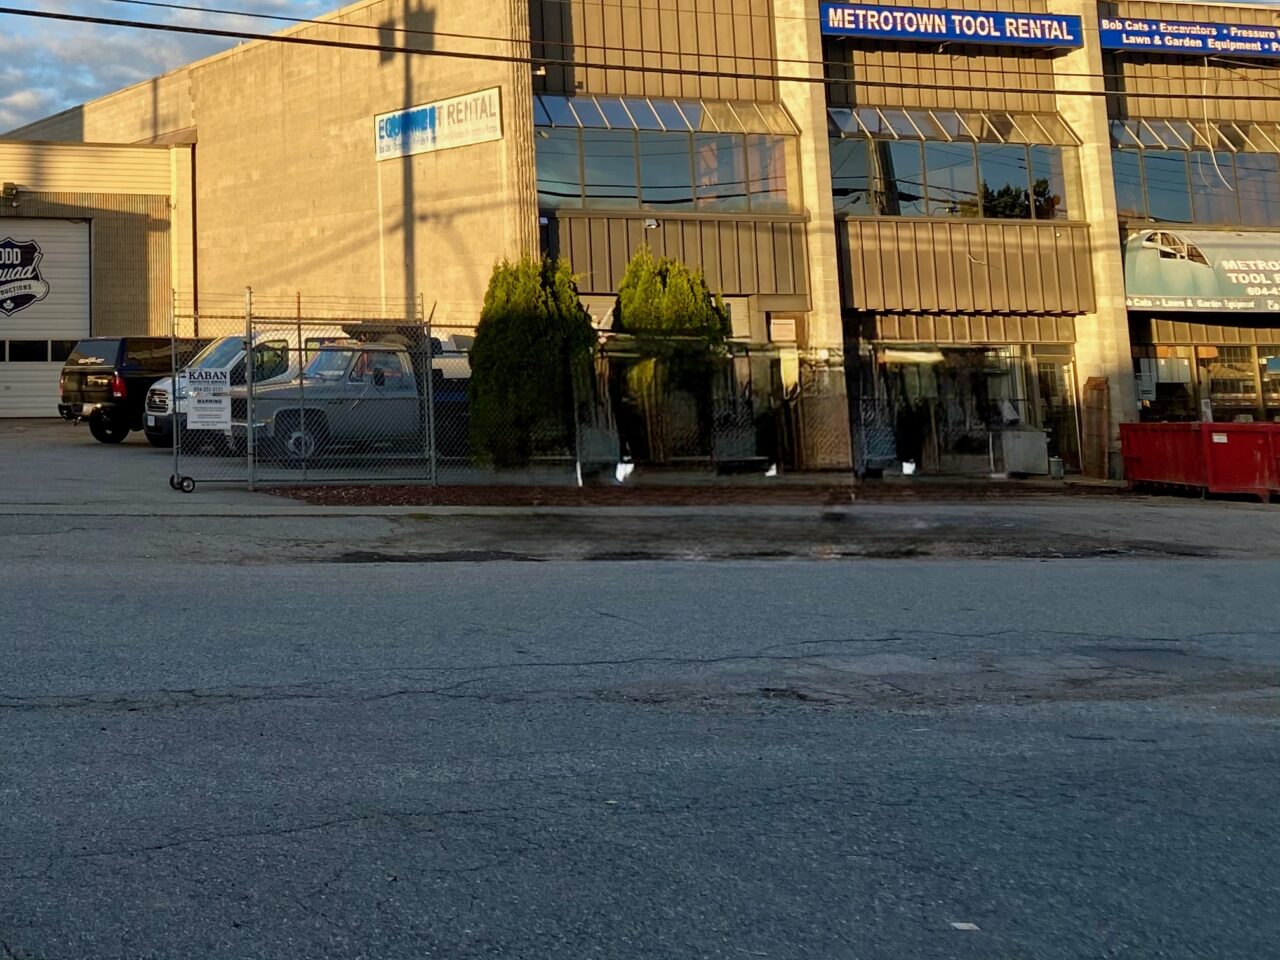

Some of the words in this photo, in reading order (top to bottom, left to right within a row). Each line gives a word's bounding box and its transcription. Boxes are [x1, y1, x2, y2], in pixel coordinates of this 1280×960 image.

[828, 7, 947, 33] METROTOWN
[951, 15, 1000, 36] TOOL
[1005, 18, 1074, 40] RENTAL
[1102, 19, 1123, 30] Bob
[1125, 21, 1149, 31] Cats
[1159, 23, 1218, 36] Excavators
[1230, 27, 1276, 39] Pressure
[1122, 34, 1151, 45] Lawn
[1153, 35, 1163, 46] &
[1165, 36, 1202, 48] Garden
[1208, 38, 1262, 51] Equipment
[447, 95, 496, 126] RENTAL
[1221, 260, 1280, 271] METRO
[1226, 272, 1272, 284] TOOL
[1246, 287, 1280, 296] 604-4
[1133, 298, 1153, 307] Cats
[1161, 298, 1185, 307] Lawn
[1197, 299, 1221, 308] Garden
[188, 371, 228, 380] KABAN
